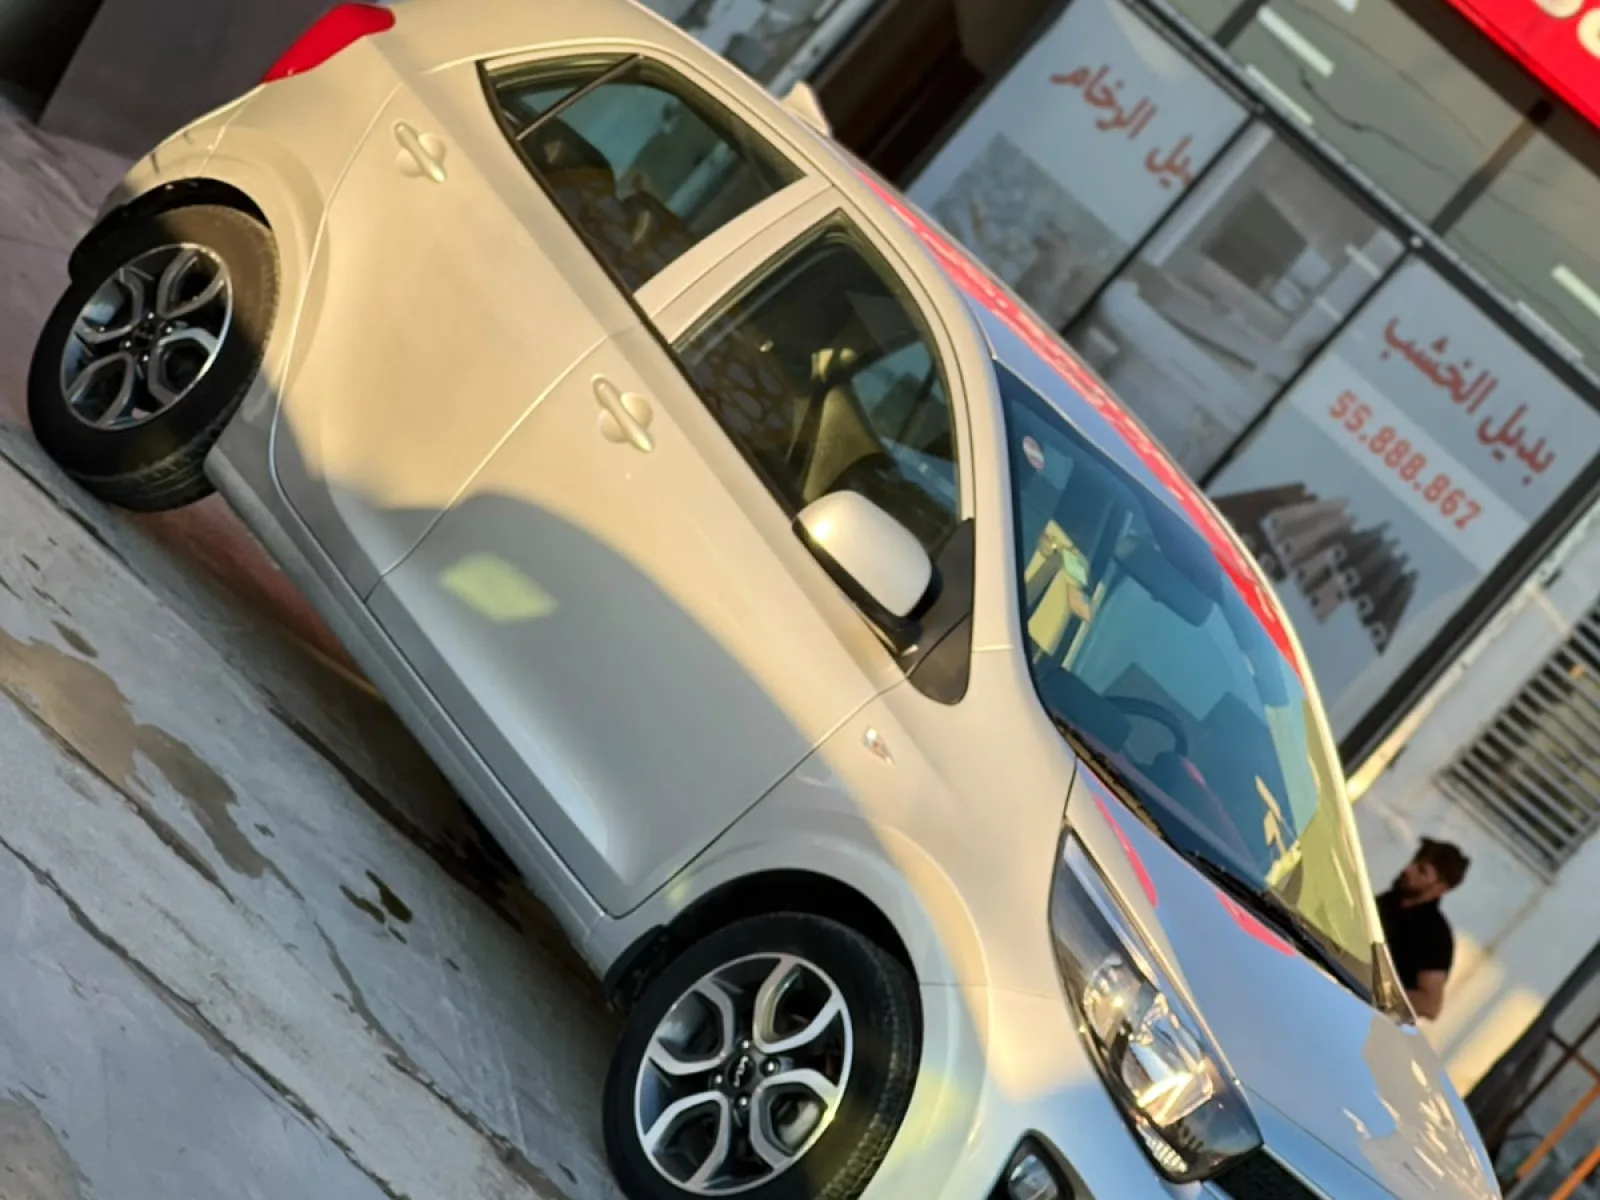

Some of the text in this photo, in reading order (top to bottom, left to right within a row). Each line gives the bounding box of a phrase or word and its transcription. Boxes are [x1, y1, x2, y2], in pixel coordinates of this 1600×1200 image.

[1049, 64, 1195, 188] يل الرخام
[1329, 388, 1482, 530] 55.888.867
[1380, 316, 1556, 486] بديل الخشب
